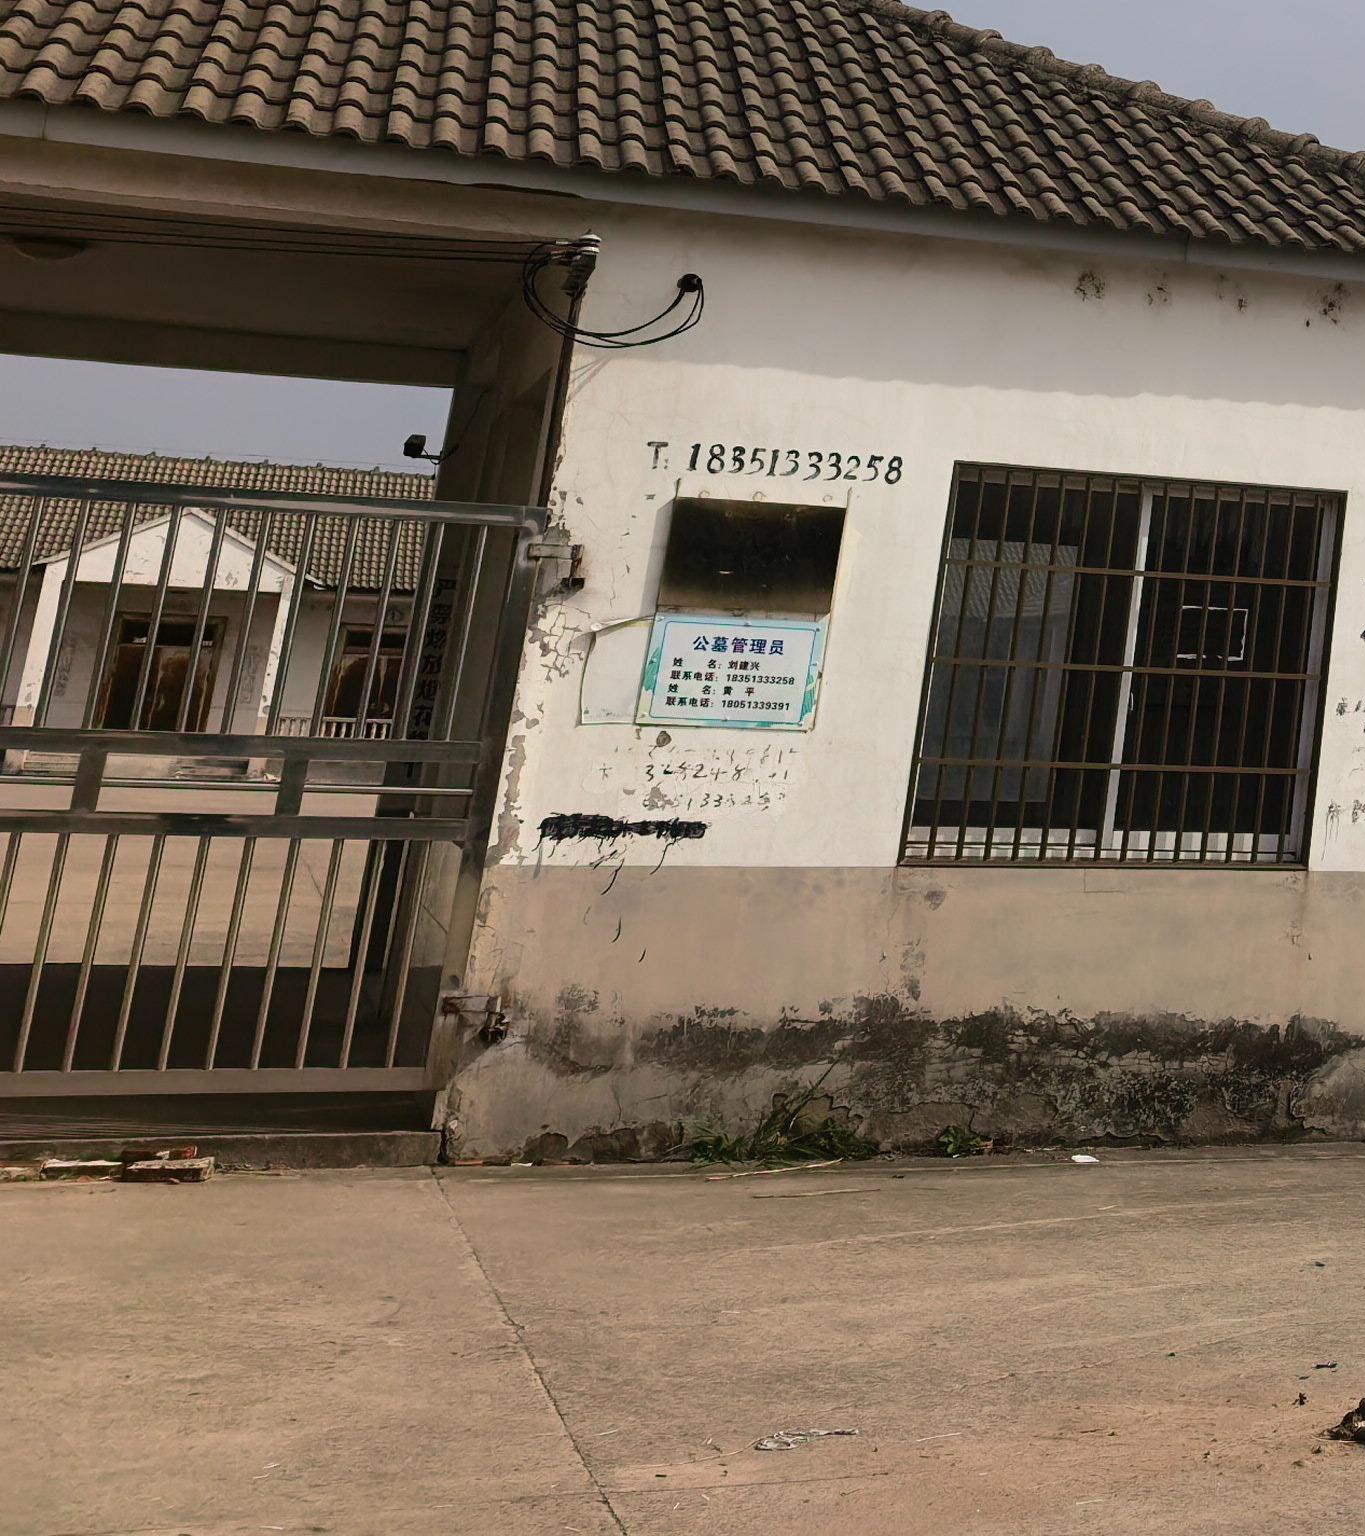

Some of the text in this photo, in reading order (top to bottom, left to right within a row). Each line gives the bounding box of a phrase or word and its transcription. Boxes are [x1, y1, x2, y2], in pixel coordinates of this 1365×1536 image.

[686, 443, 904, 485] 18351333258
[693, 635, 785, 656] 公墓管理员
